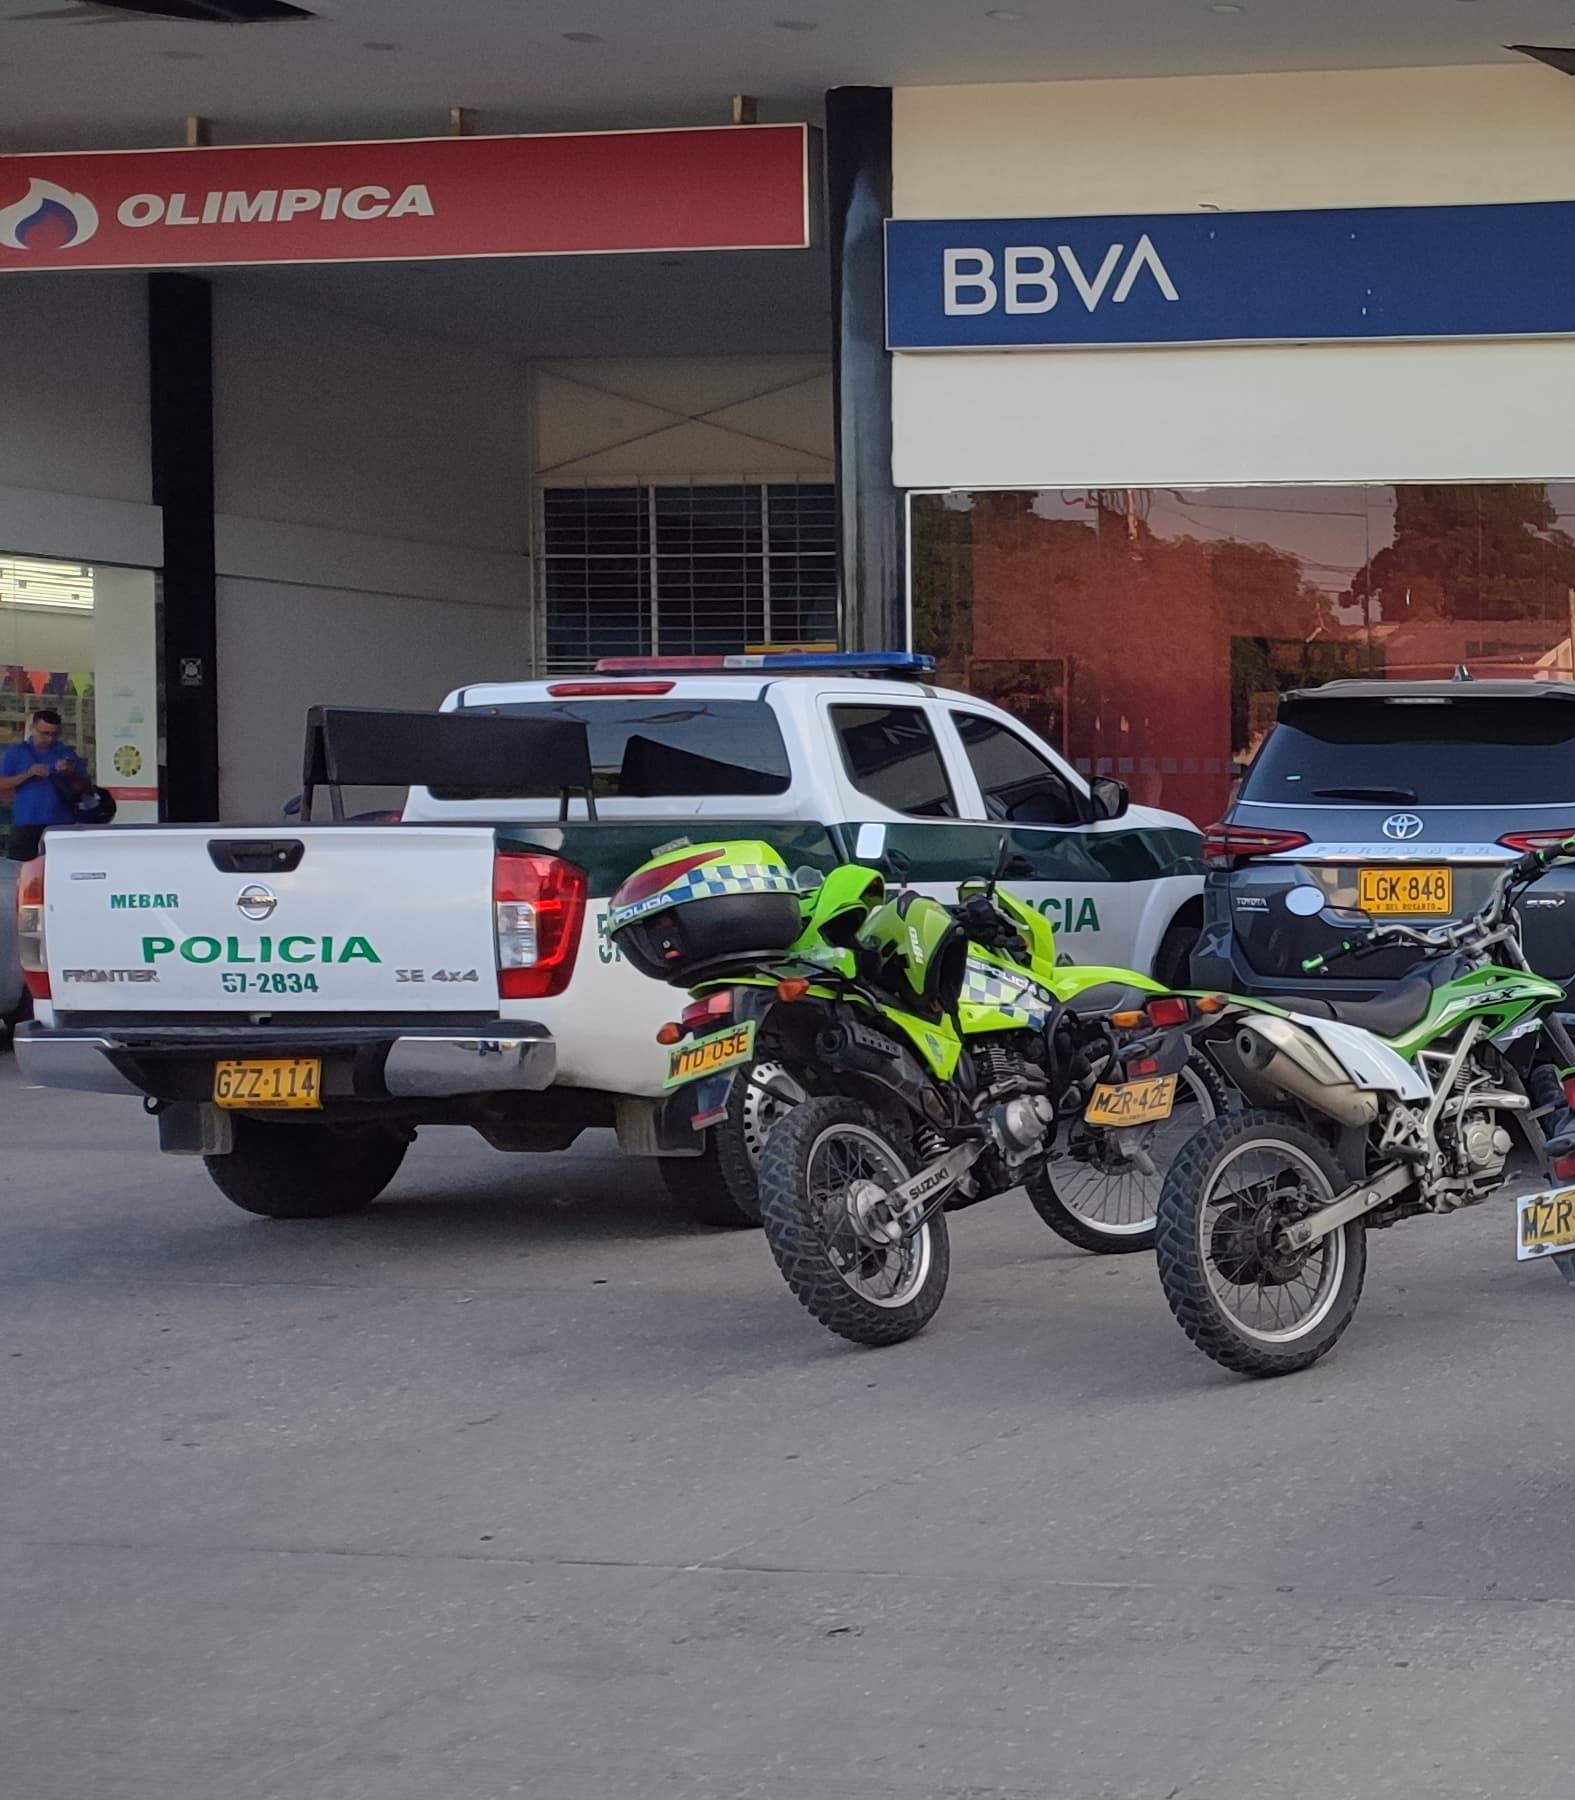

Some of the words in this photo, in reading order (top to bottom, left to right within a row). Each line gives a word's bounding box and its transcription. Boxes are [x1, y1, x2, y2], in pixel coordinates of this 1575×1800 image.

[117, 184, 434, 228] OLIMPICA
[943, 234, 1180, 316] BBVA
[111, 894, 179, 909] MEBAR
[1236, 897, 1268, 907] TOYOTA
[141, 936, 382, 964] POLICIA
[62, 969, 160, 984] FRONTIER
[221, 973, 319, 994] 57-2834
[395, 969, 425, 983] SE
[909, 1167, 950, 1200] SUZUKI
